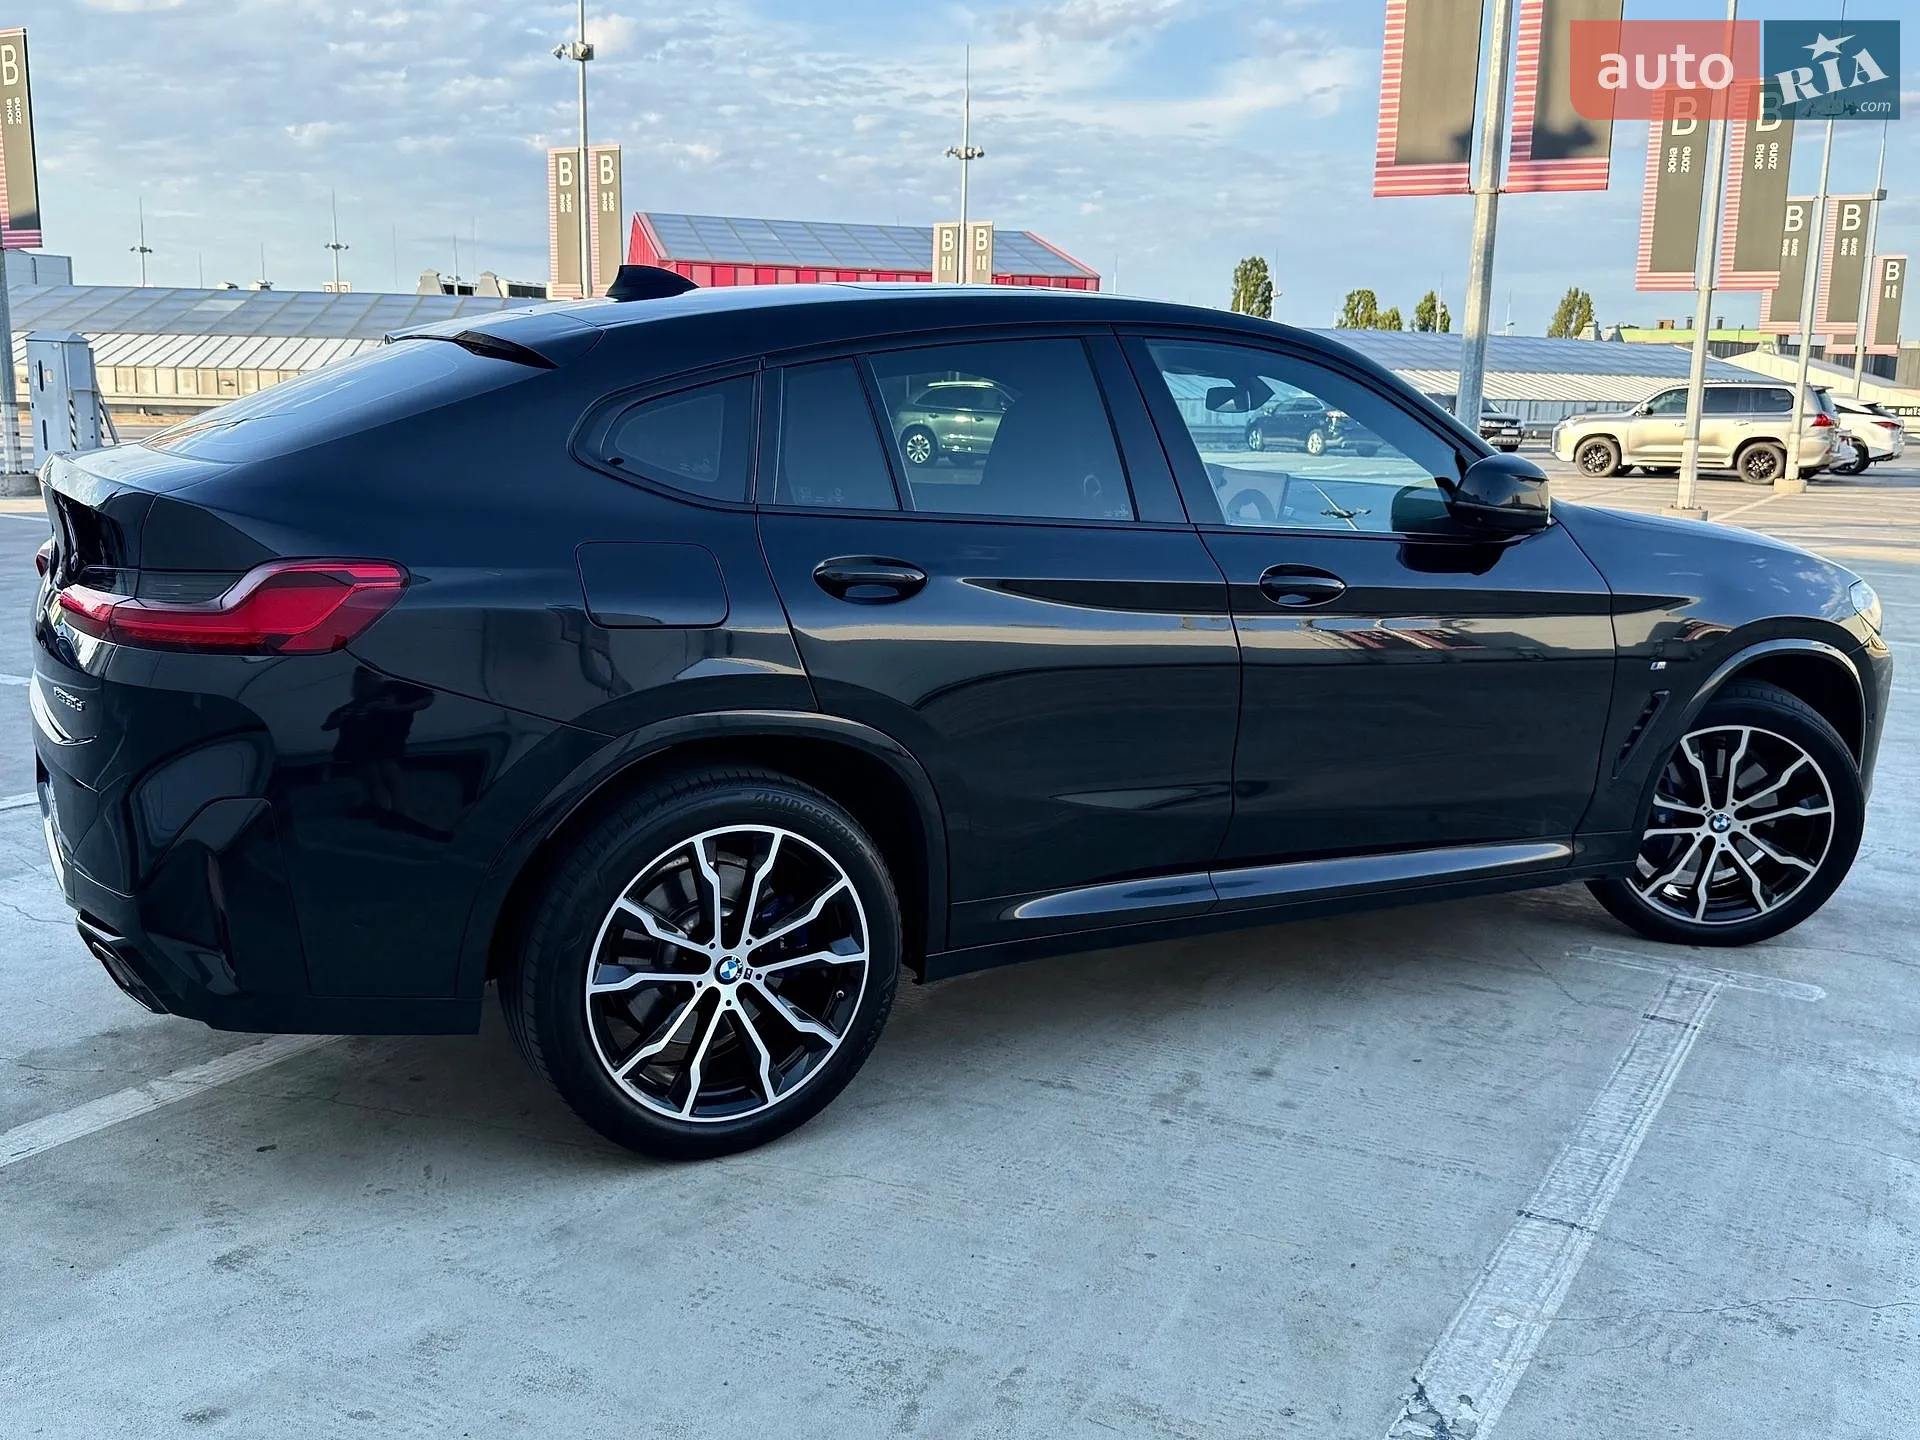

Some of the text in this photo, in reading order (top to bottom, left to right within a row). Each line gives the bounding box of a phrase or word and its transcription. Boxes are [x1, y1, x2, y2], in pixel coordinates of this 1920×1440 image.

[1, 44, 19, 86] B
[1671, 96, 1698, 136] B
[1756, 91, 1783, 132] B
[1667, 147, 1678, 173] зона
[1680, 146, 1692, 173] zone
[1754, 143, 1765, 170] зона
[1768, 142, 1779, 170] zone
[558, 157, 573, 186] B
[600, 155, 615, 185] B
[1784, 205, 1804, 232] B
[1841, 204, 1861, 231] B
[942, 229, 954, 252] B
[975, 228, 988, 251] B
[1885, 261, 1900, 281] B
